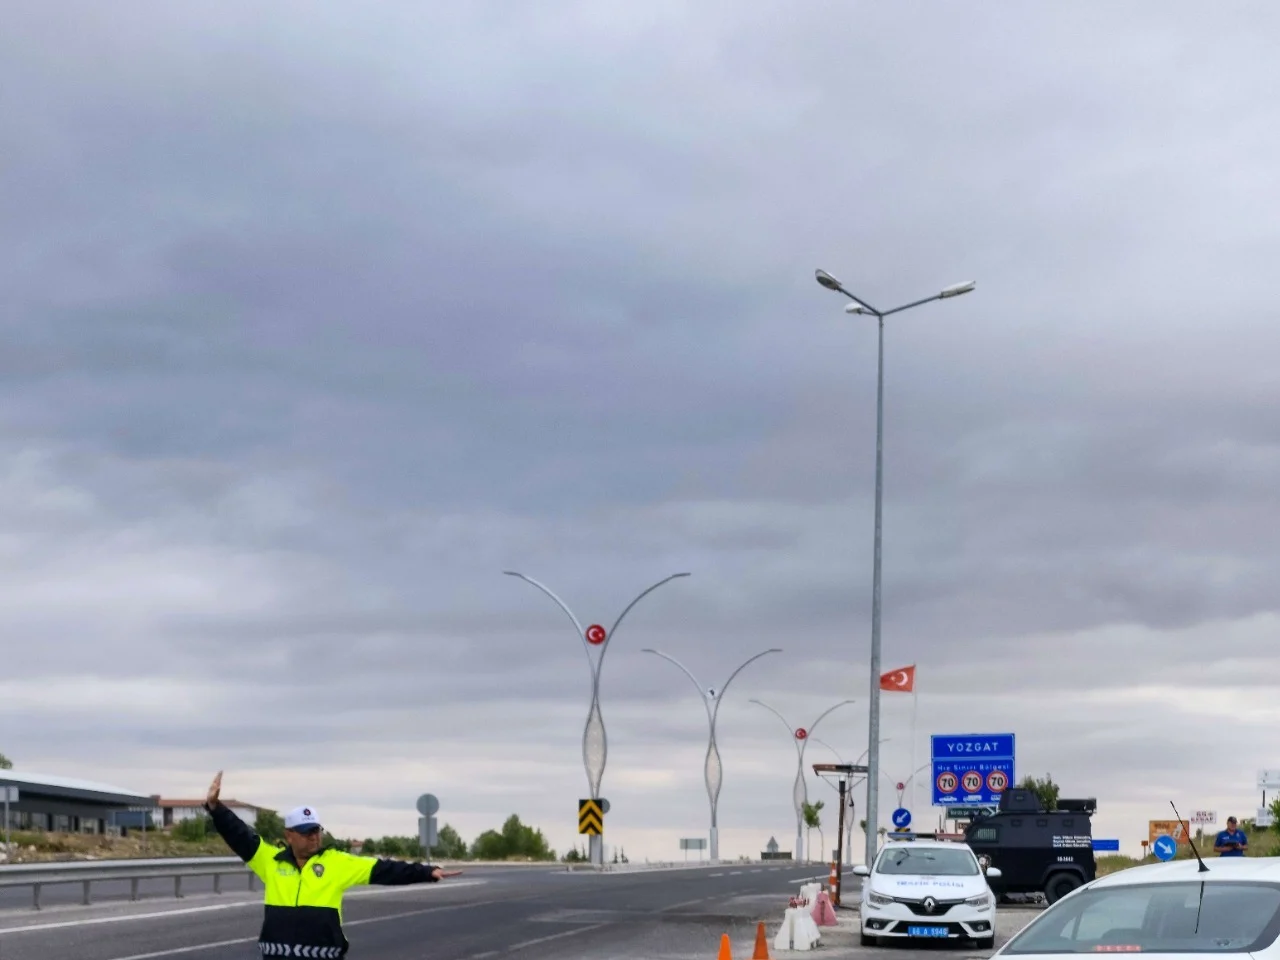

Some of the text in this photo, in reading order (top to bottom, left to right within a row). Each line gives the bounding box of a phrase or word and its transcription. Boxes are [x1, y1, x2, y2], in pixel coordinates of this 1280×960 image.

[947, 742, 998, 752] YOZGAT
[941, 778, 954, 788] 70
[966, 777, 979, 787] 70
[991, 776, 1004, 787] 70
